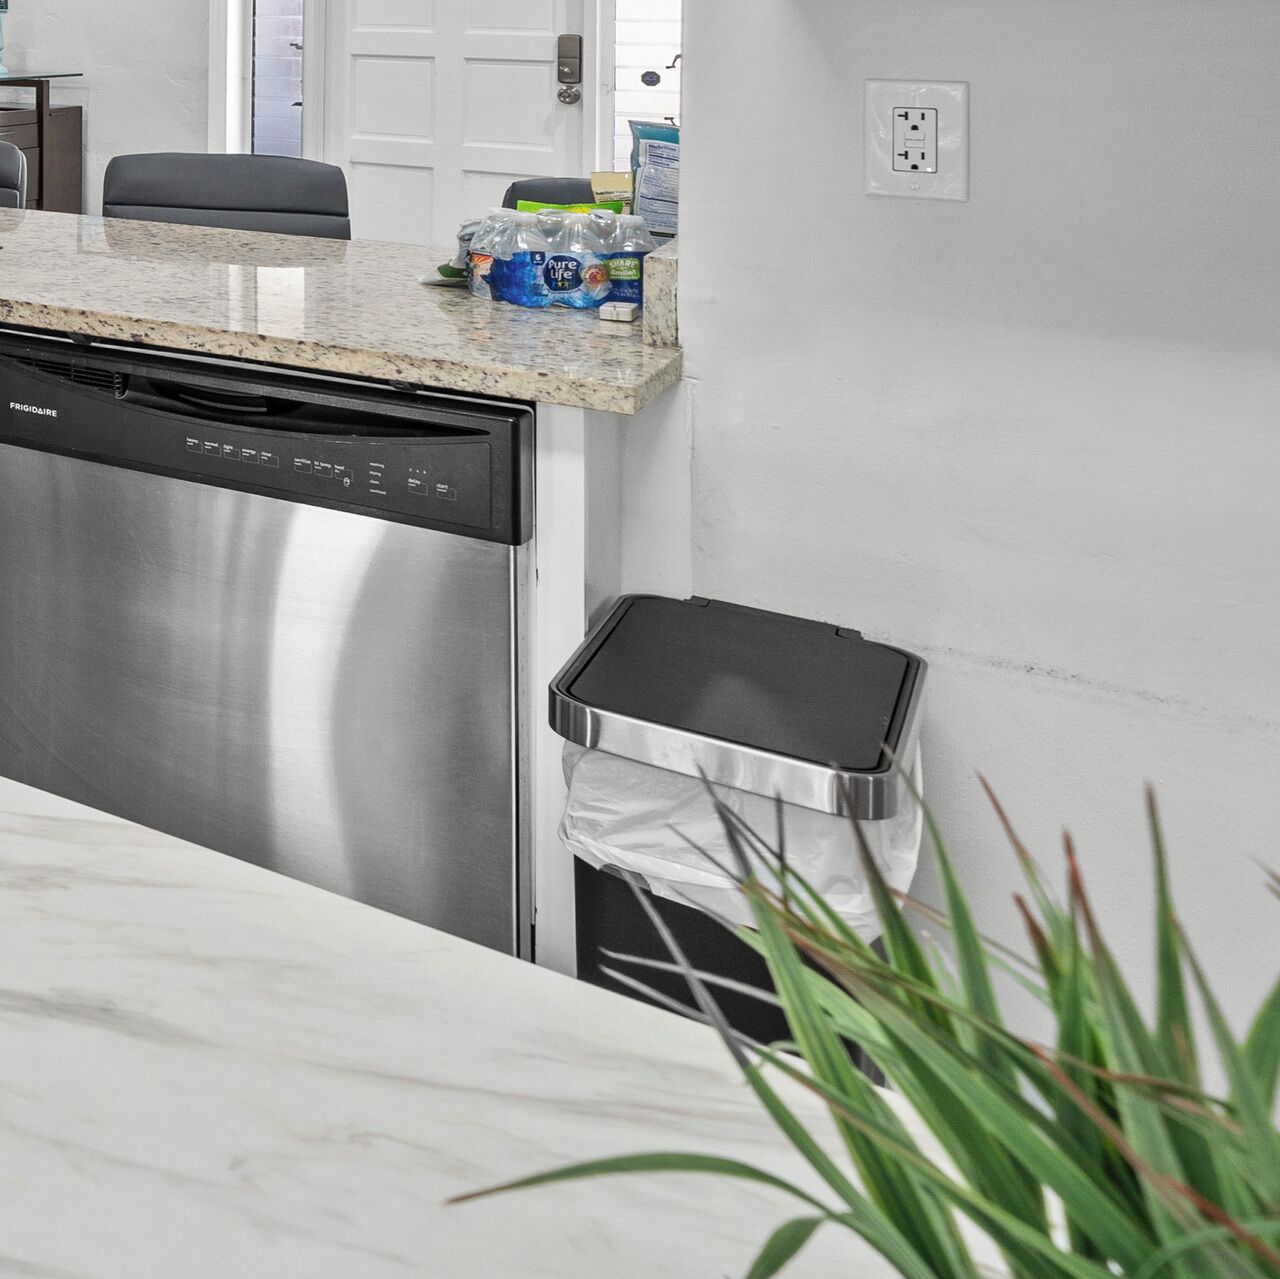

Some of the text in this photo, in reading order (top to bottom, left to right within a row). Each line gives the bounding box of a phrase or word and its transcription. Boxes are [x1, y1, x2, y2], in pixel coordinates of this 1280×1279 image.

[548, 259, 578, 270] Pure
[550, 268, 573, 281] Life
[9, 401, 58, 418] FRIGIDAIRE
